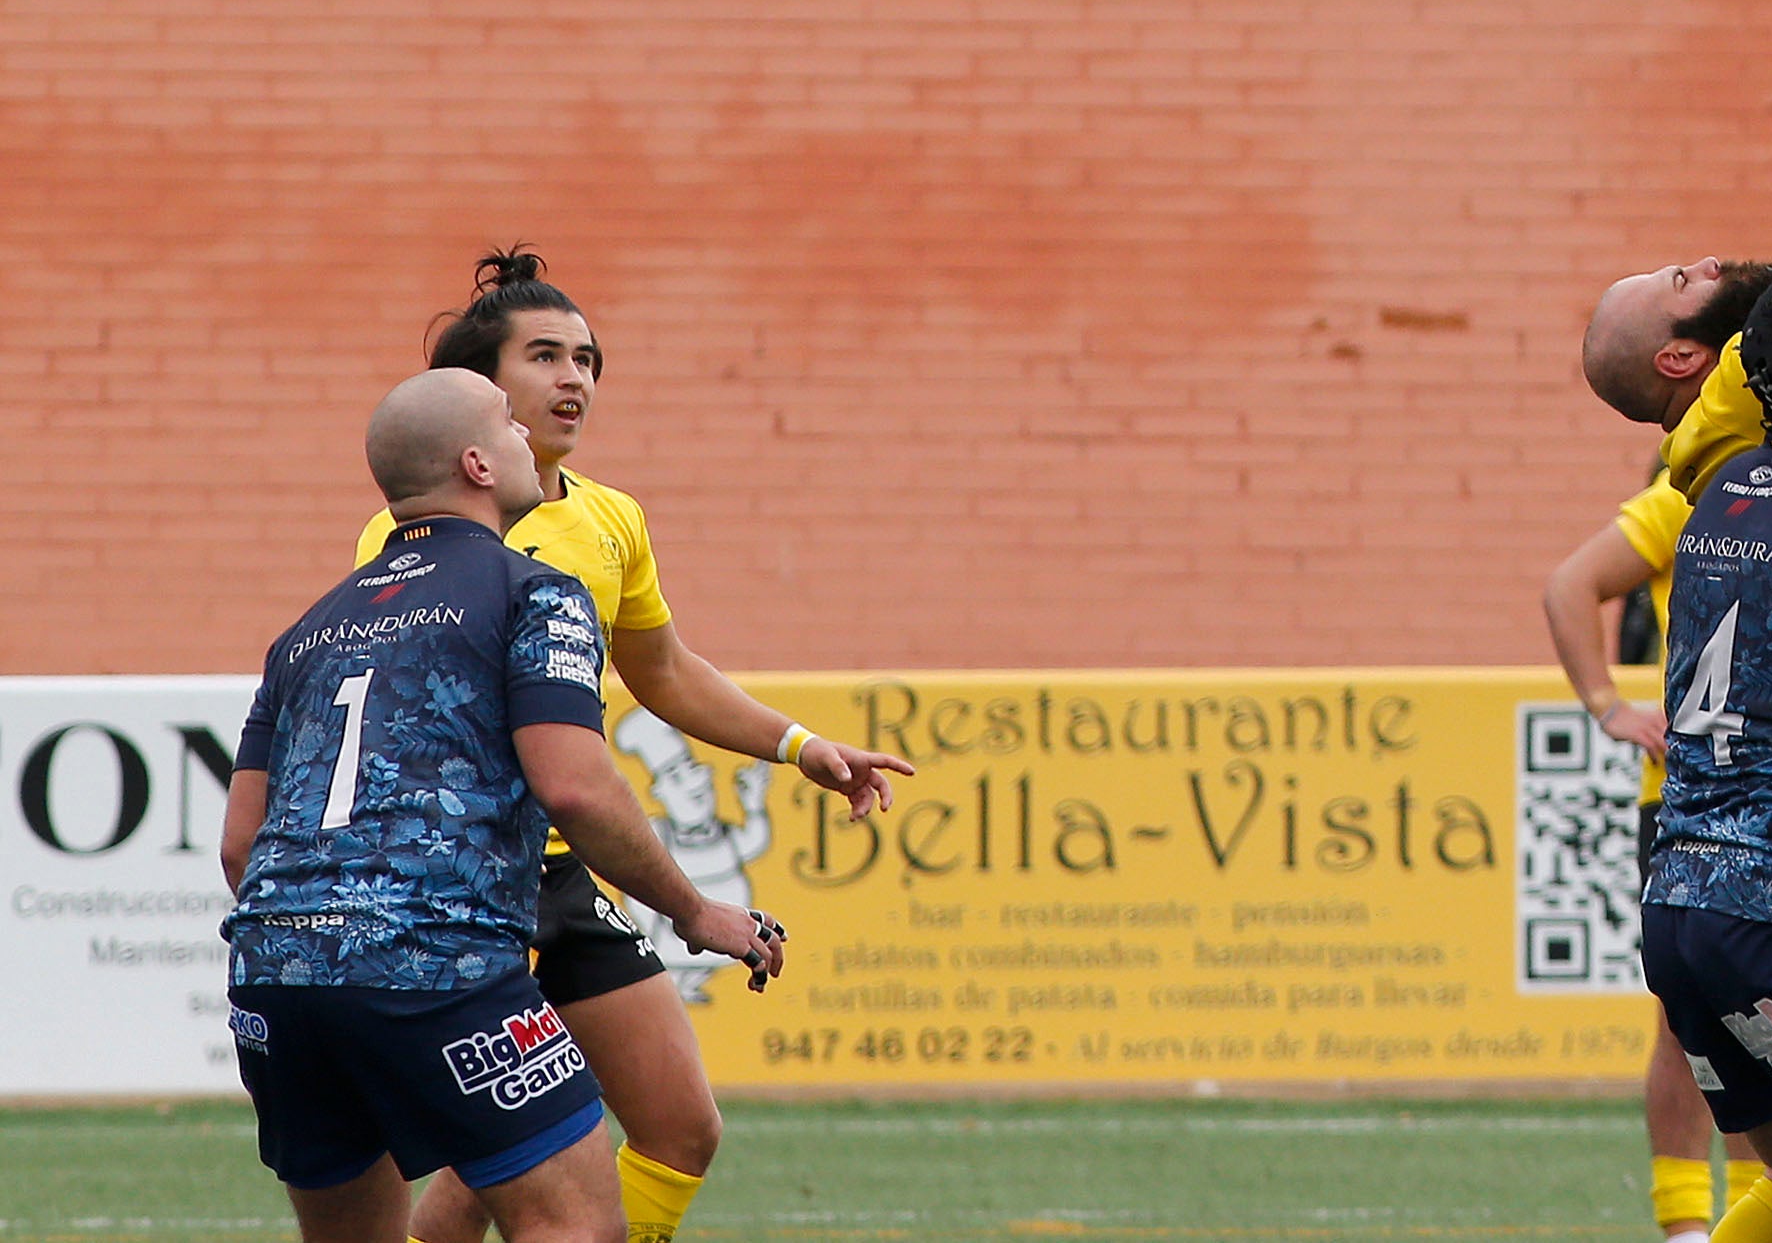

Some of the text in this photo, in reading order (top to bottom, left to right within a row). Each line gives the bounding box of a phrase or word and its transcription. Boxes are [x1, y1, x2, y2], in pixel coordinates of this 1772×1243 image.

[851, 678, 1418, 764] Restaurante
[1672, 599, 1744, 767] 4
[320, 667, 375, 831] 1
[0, 719, 236, 857] ON
[790, 758, 1498, 889] Bella-Vista
[908, 900, 965, 929] bar
[998, 901, 1198, 929] restaurante
[832, 937, 1447, 976] platos combinados hamburguesas
[806, 976, 1469, 1016] tortillas de patata comida para llevar
[492, 1041, 585, 1110] Garro
[762, 1027, 842, 1063] 947
[852, 1027, 906, 1062] 46
[915, 1026, 970, 1061] 02
[981, 1025, 1035, 1061] 22
[1261, 1028, 1304, 1061] de
[1314, 1029, 1433, 1064] Burgos
[1443, 1025, 1544, 1059] desde
